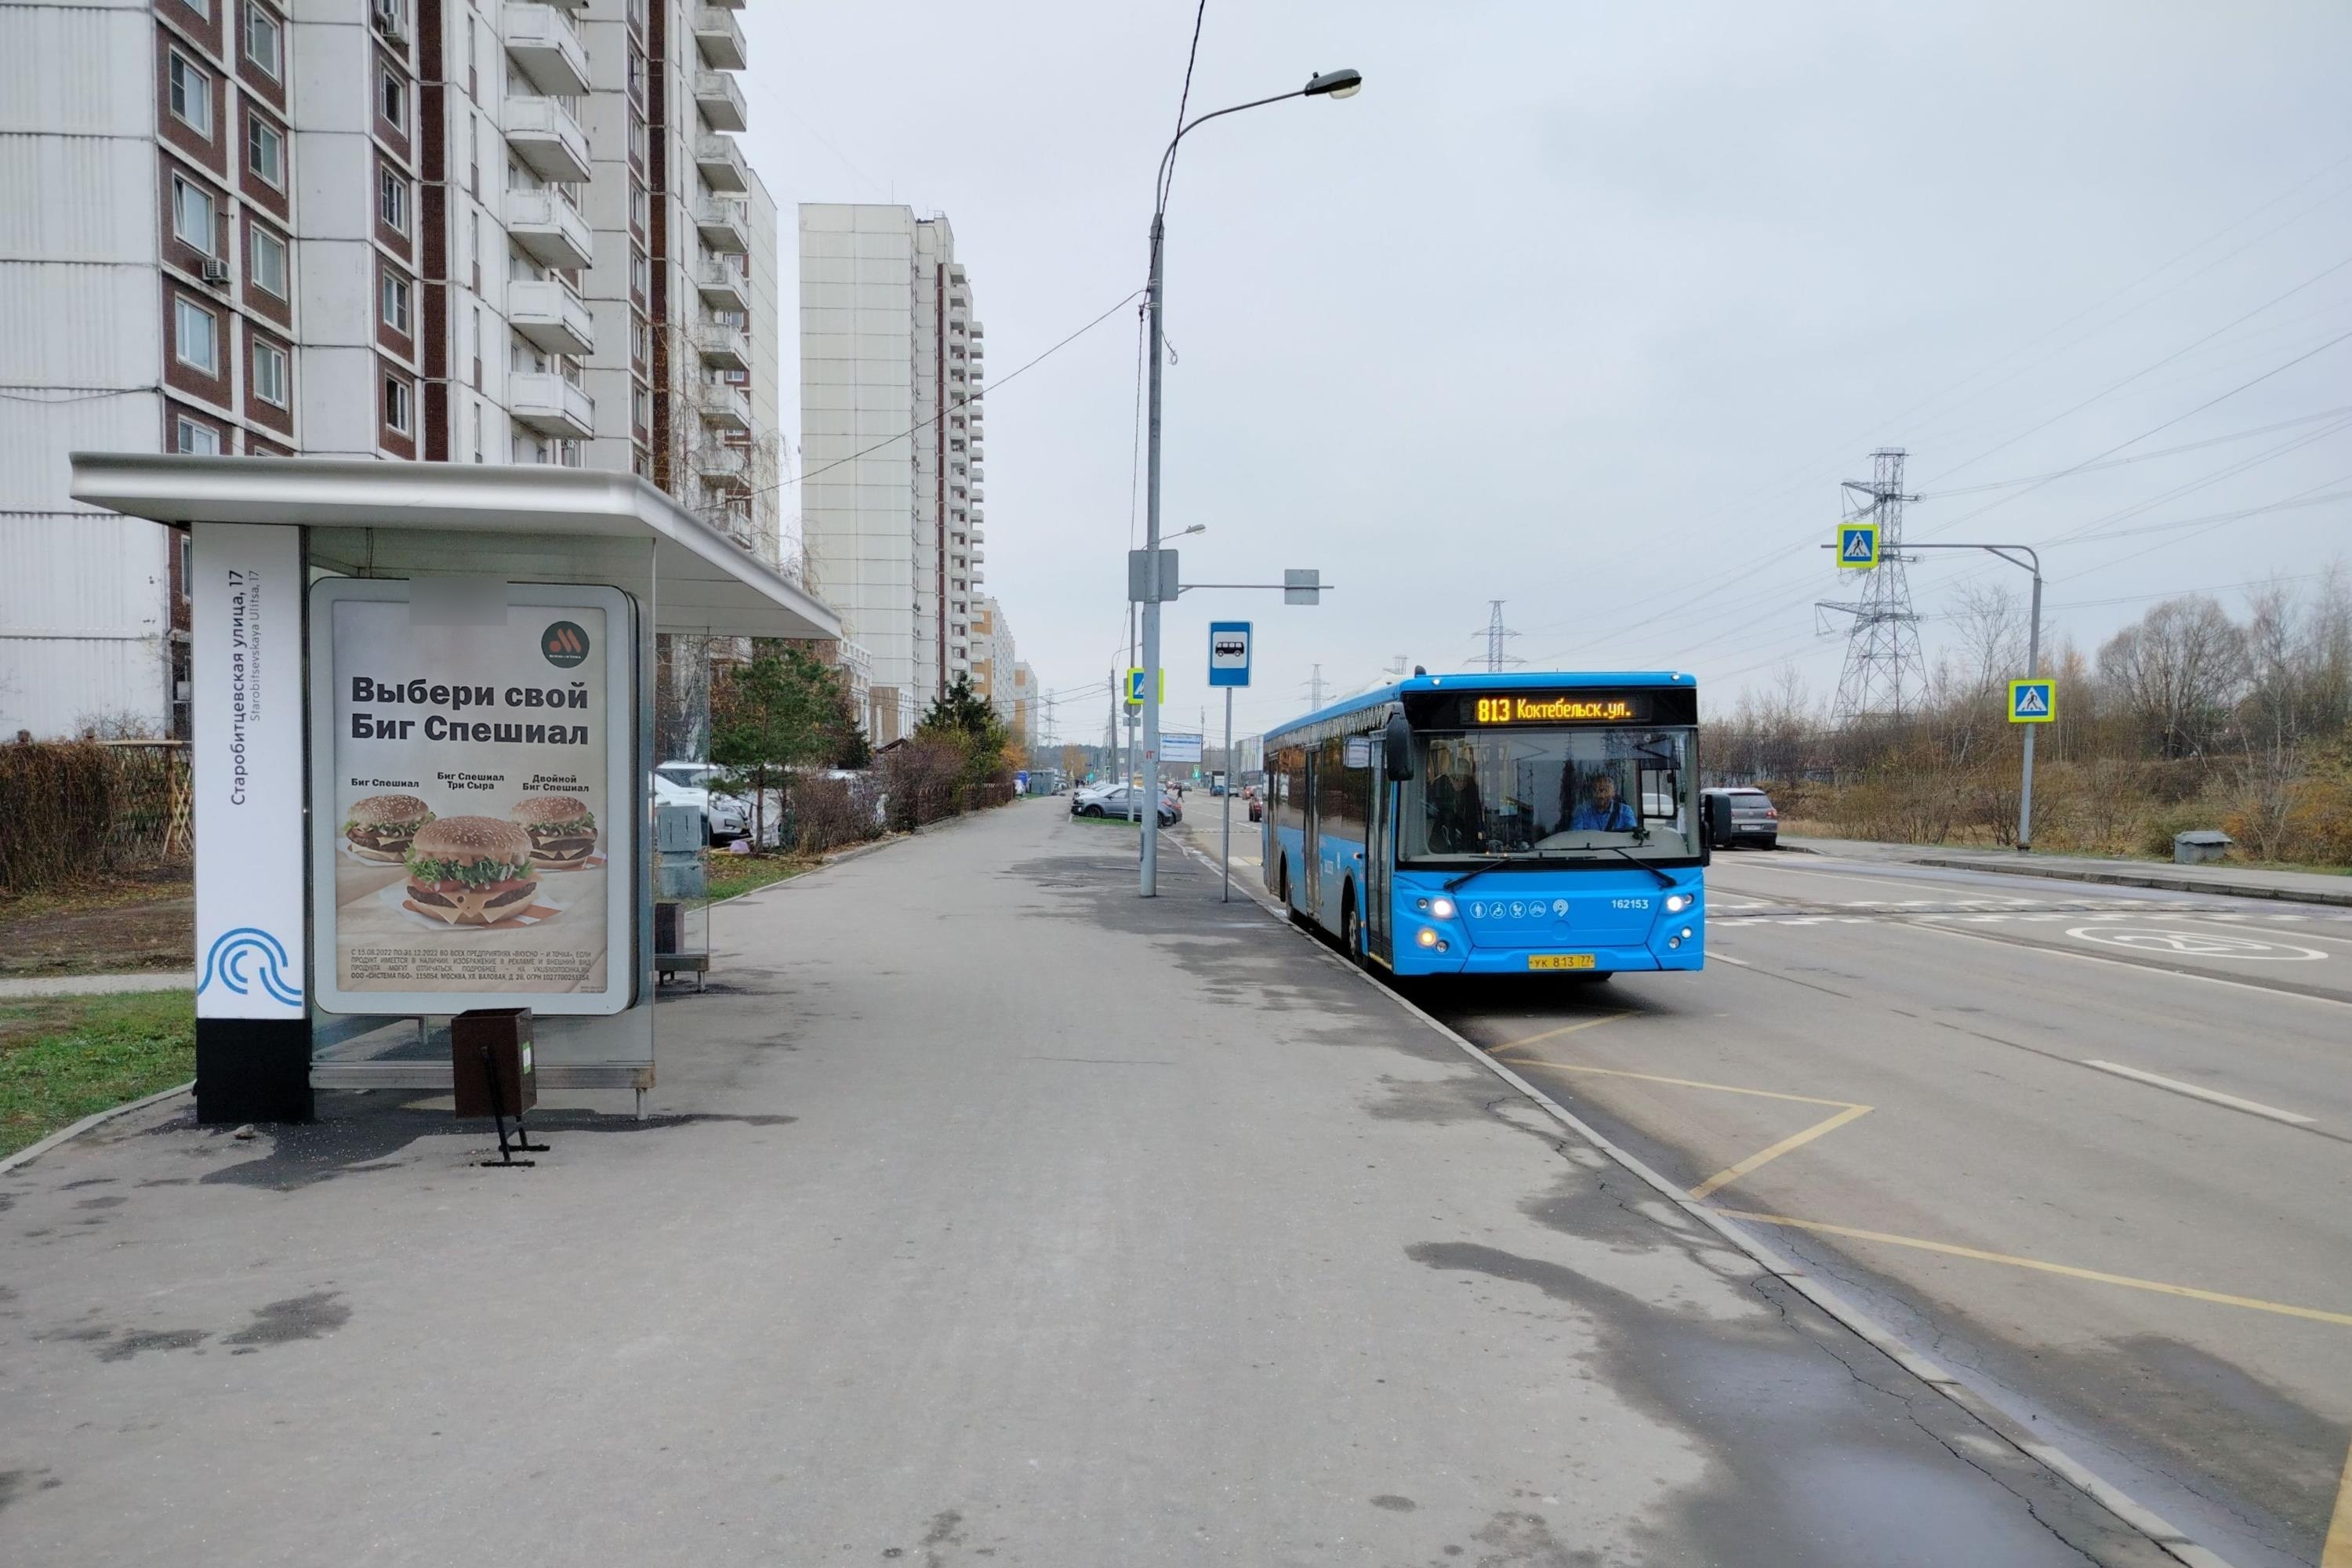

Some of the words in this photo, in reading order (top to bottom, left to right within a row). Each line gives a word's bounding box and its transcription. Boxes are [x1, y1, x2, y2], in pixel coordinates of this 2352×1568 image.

[229, 570, 243, 586] 17
[249, 570, 260, 582] 17
[249, 584, 260, 620] Ulitsa,
[232, 592, 248, 648] улица,
[249, 624, 261, 721] Starobitsevskaya
[352, 677, 495, 710] Выбери
[505, 681, 588, 709] свой
[1478, 699, 1510, 722] 813
[230, 653, 249, 805] Старобитцевская
[352, 713, 416, 739] Биг
[424, 715, 588, 745] Спешиал
[350, 778, 370, 786] Биг
[372, 779, 419, 788] Спешиал
[437, 771, 456, 780] Биг
[458, 772, 504, 781] Спешиал
[532, 774, 577, 784] Двойной
[447, 781, 465, 790] Три
[466, 782, 495, 791] Сыра
[522, 782, 541, 791] Биг
[543, 783, 590, 792] Спешиал
[1611, 899, 1649, 909] 162153
[1553, 956, 1574, 967] 813
[1580, 955, 1591, 964] 77
